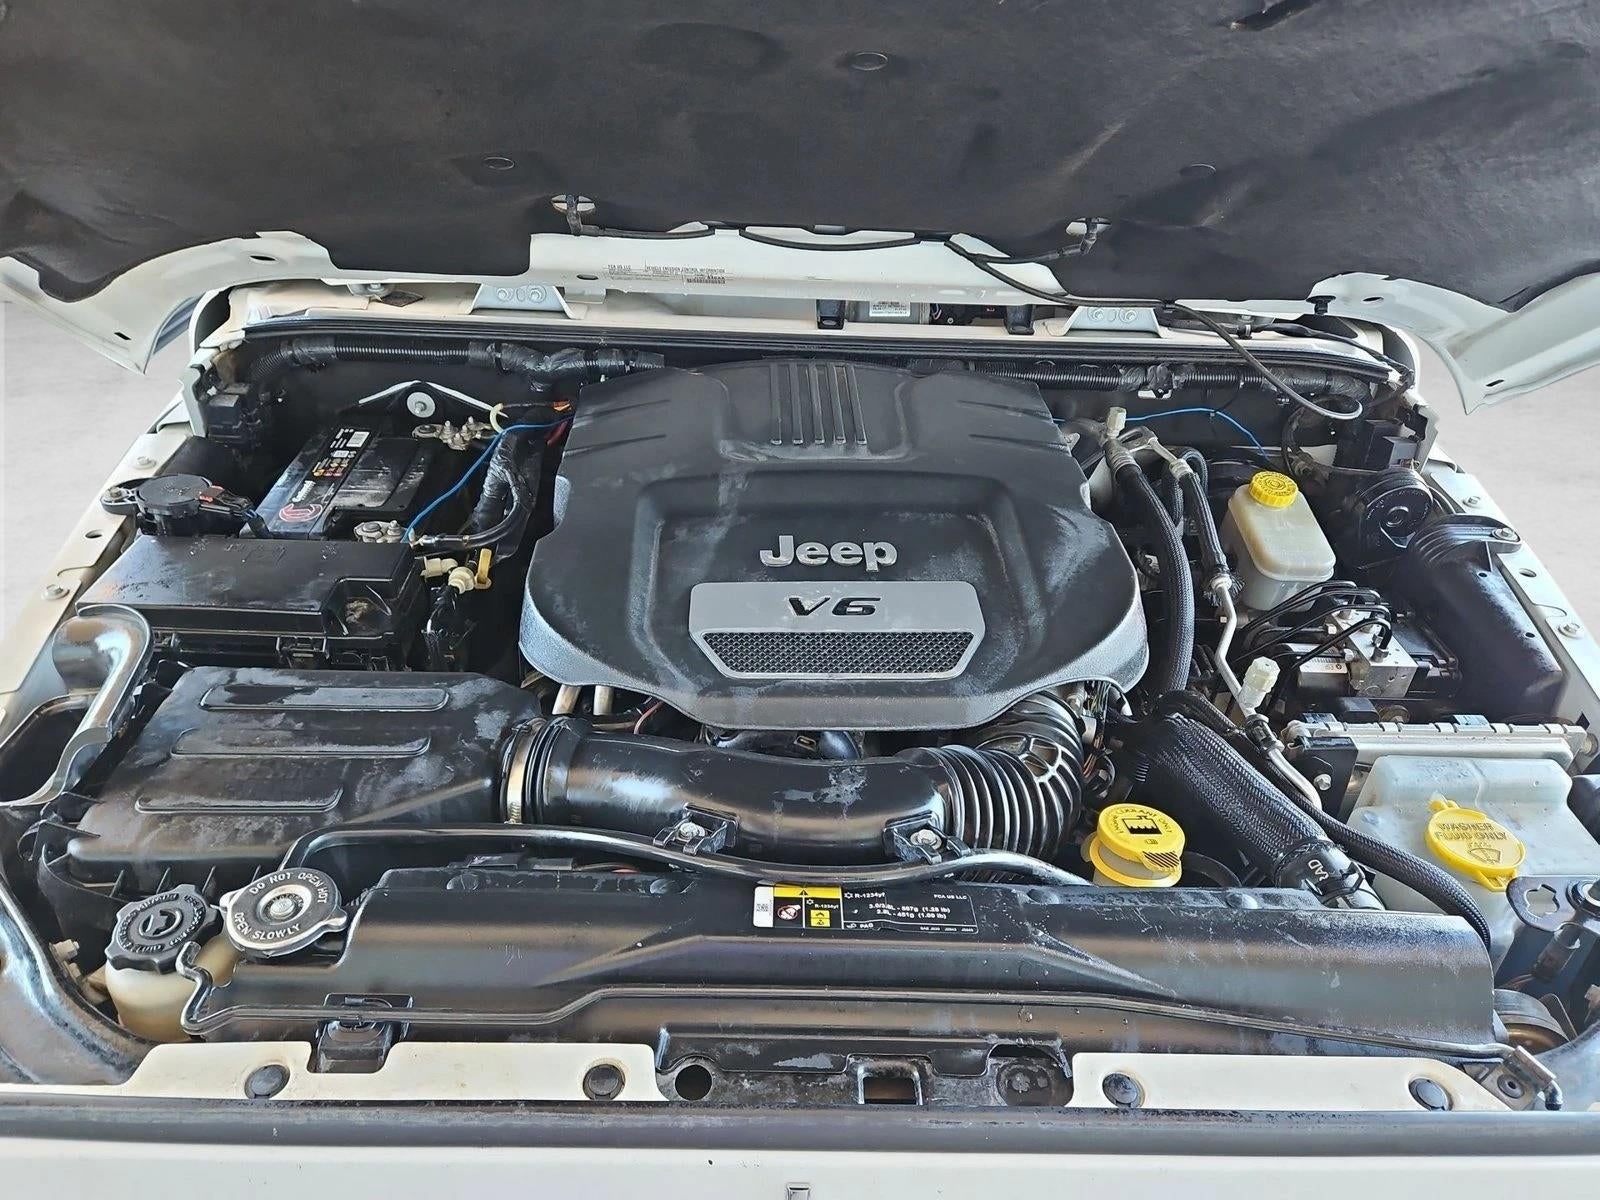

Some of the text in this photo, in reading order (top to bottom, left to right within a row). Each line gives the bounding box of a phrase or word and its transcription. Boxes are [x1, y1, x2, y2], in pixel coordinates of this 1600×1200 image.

[759, 535, 898, 572] Jeep
[788, 597, 881, 616] V6
[1435, 831, 1508, 841] FLUID ONLY
[1438, 822, 1495, 831] WASHER
[249, 872, 327, 904] DO NOT OPEN HOT
[234, 912, 302, 940] OPEN SLOWLY
